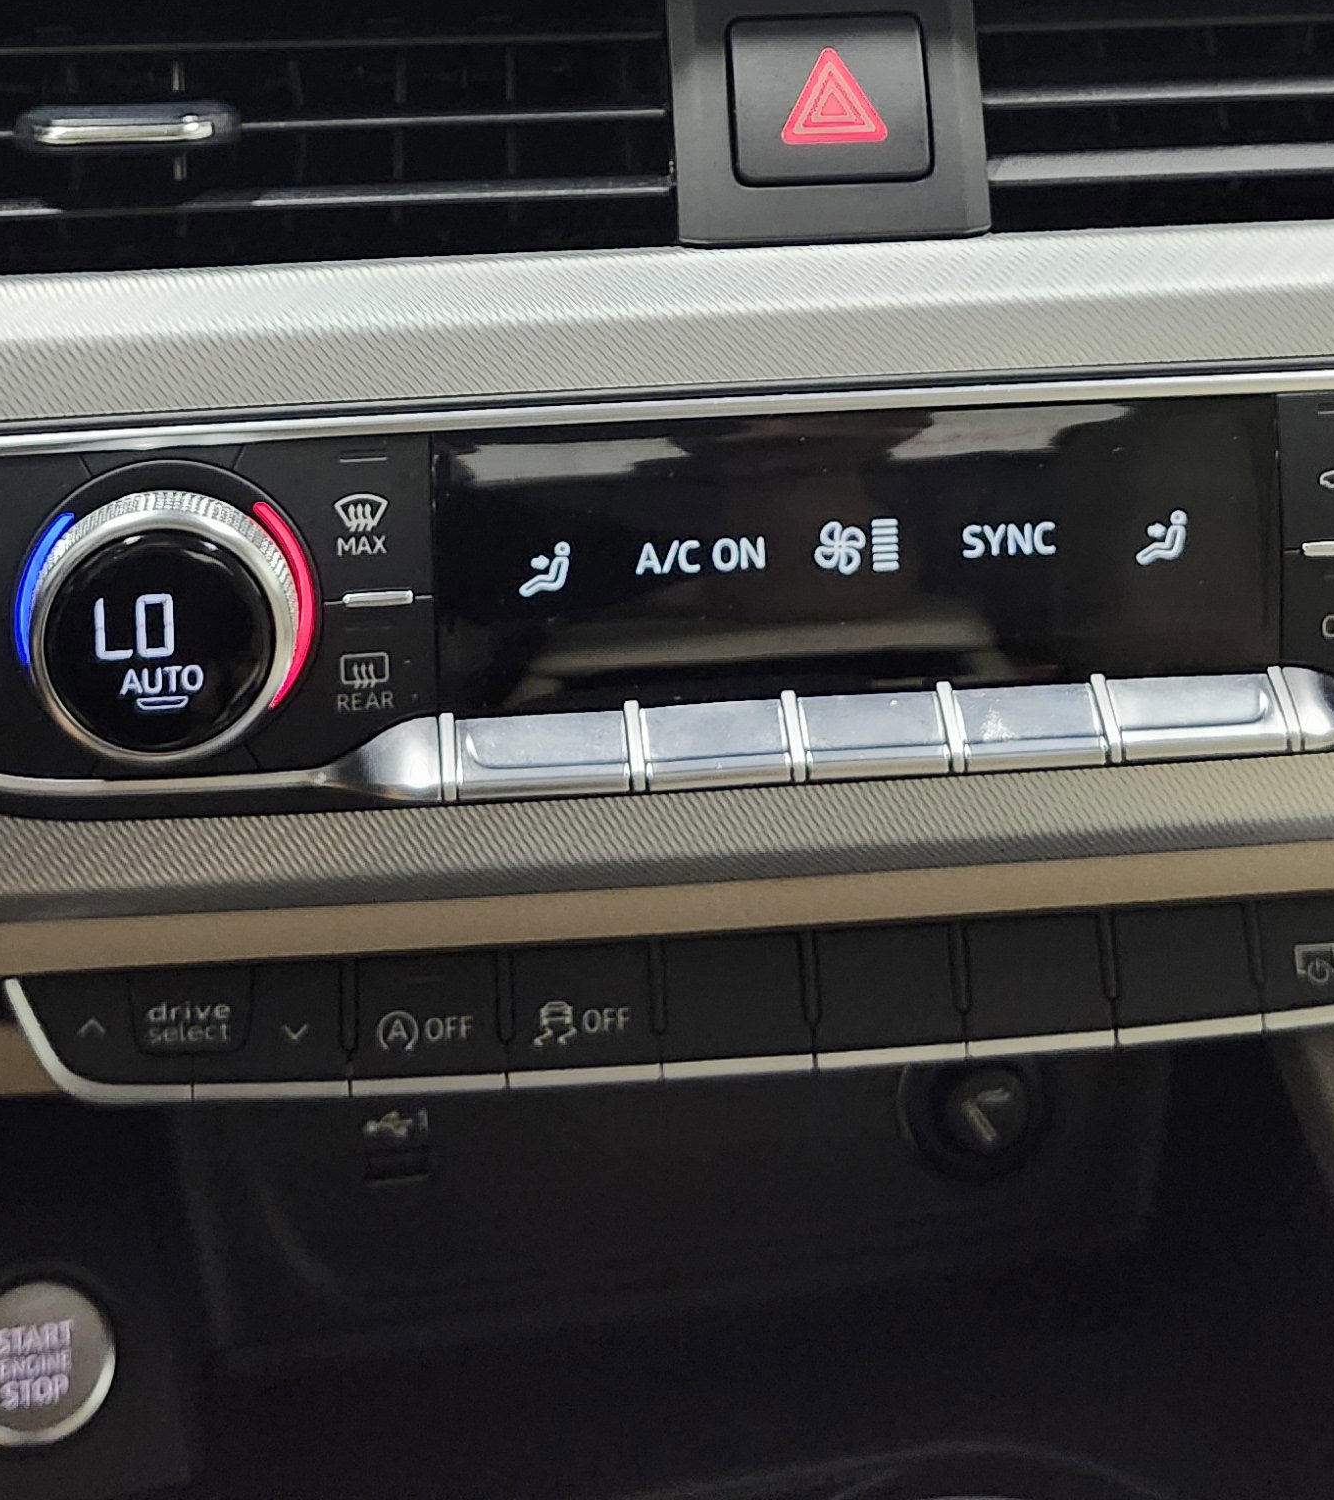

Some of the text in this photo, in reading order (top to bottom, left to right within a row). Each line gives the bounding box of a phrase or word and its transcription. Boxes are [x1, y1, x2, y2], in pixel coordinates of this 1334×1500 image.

[336, 536, 387, 556] MAX
[962, 522, 1057, 557] SYNC
[636, 537, 766, 575] A/C ON
[93, 592, 174, 661] LO
[120, 664, 205, 695] AUTO
[336, 693, 394, 710] REAR
[147, 1000, 231, 1024] drive
[582, 1008, 630, 1033] OFF
[147, 1021, 229, 1044] select
[425, 1016, 473, 1041] OFF
[0, 1374, 69, 1410] STOP
